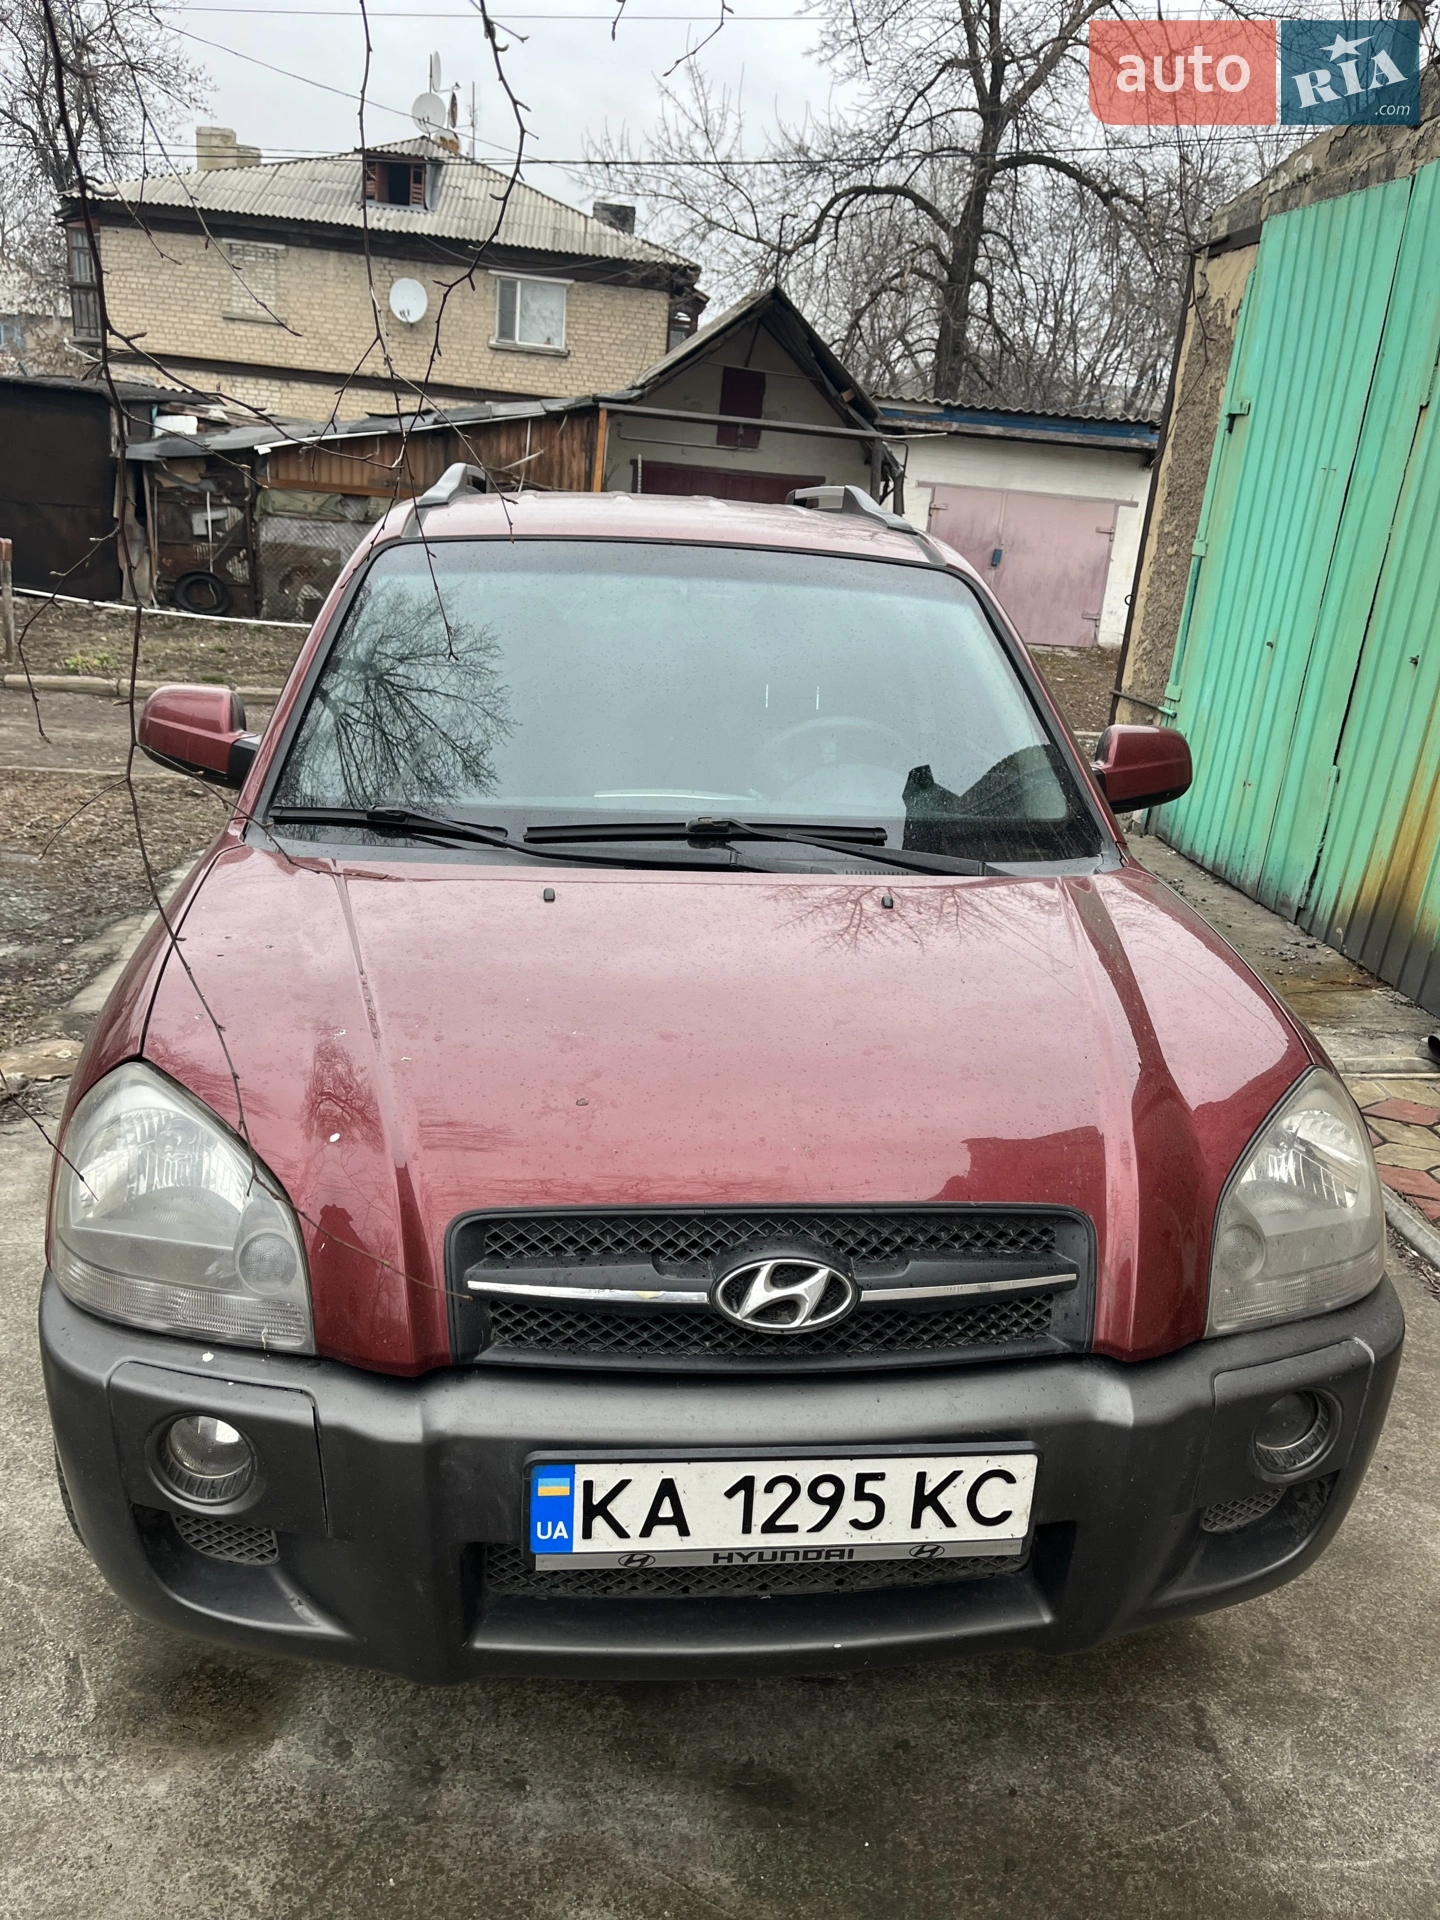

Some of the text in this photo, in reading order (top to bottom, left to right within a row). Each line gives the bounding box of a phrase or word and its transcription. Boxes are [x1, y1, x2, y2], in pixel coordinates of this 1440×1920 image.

[581, 1468, 1018, 1539] KA 1295 KC
[536, 1520, 569, 1540] UA
[712, 1548, 854, 1564] HYUNDAI
